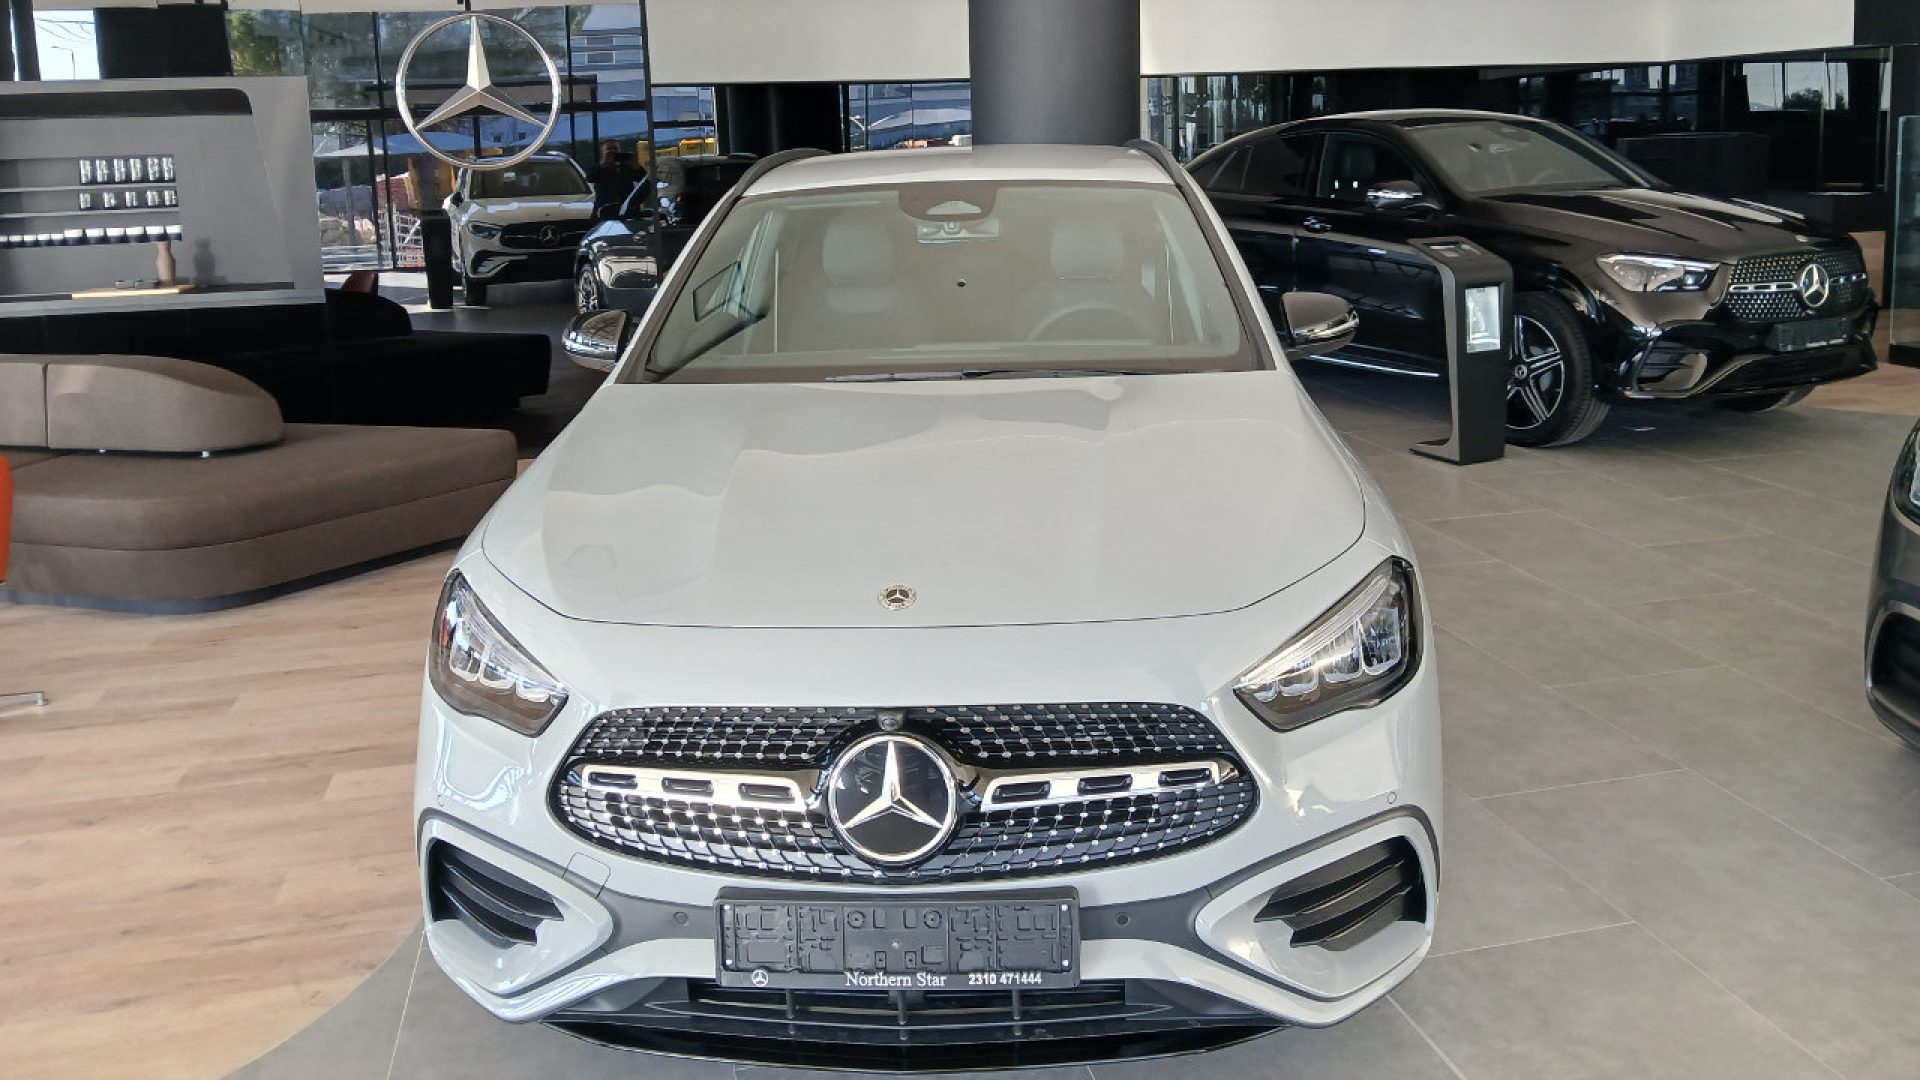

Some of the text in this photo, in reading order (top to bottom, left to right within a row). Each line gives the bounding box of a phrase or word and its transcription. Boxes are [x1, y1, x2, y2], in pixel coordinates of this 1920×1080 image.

[845, 971, 948, 987] Northern Star
[968, 972, 1042, 985] 2310 471444
